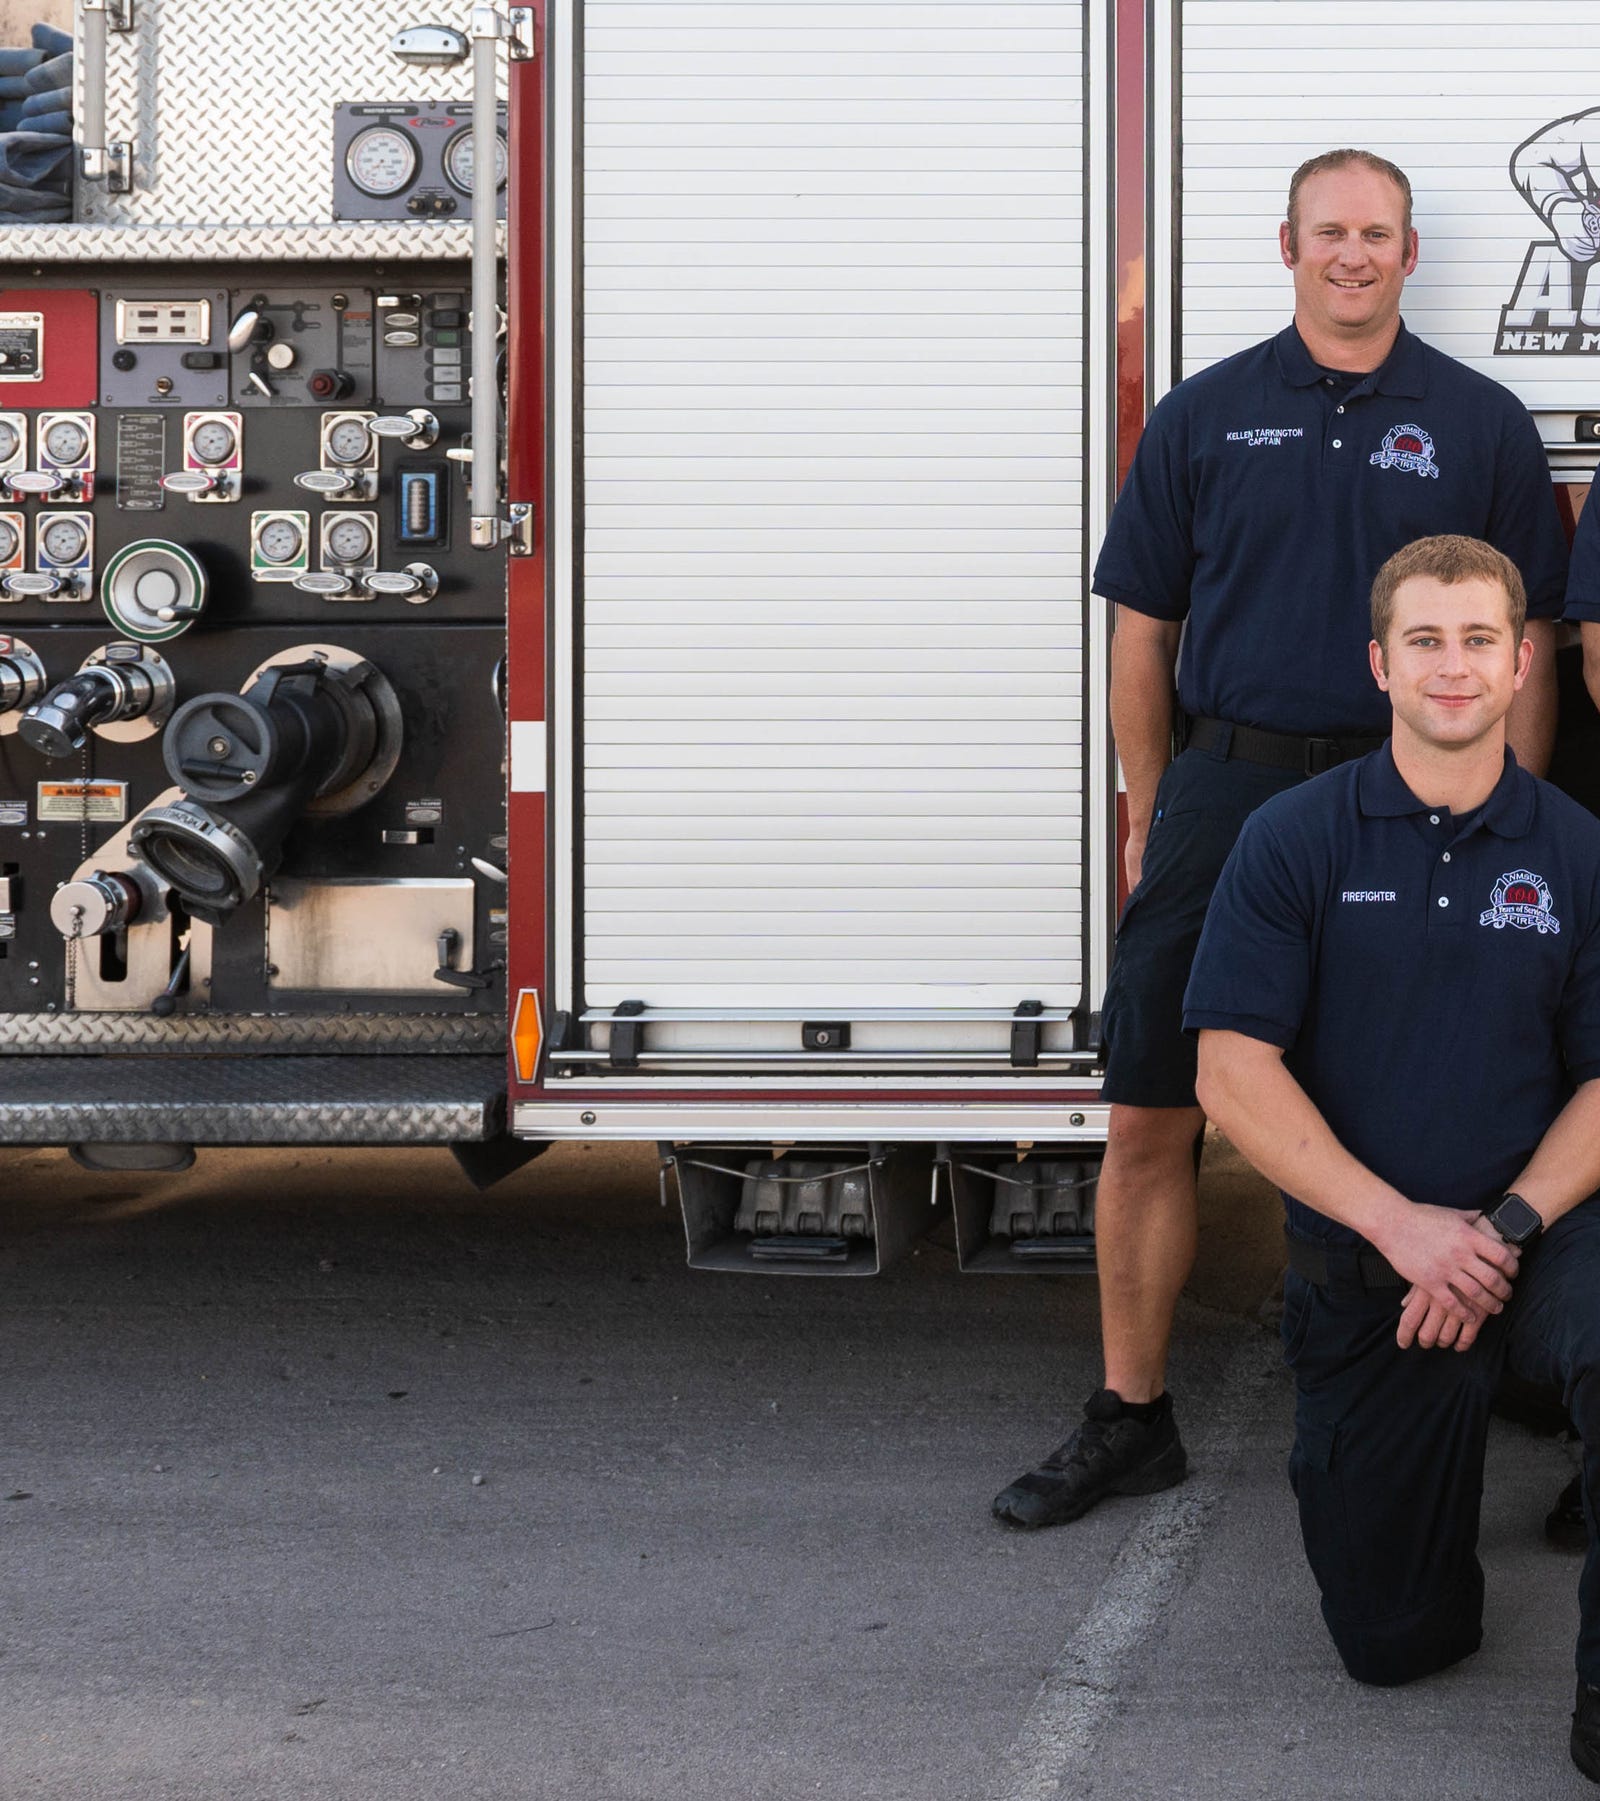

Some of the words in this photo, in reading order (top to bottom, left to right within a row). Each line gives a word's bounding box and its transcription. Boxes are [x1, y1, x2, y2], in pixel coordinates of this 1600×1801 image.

[1500, 331, 1569, 351] NEW
[1226, 430, 1254, 441] KELLEN
[1254, 428, 1303, 438] TARKINGTON
[1400, 426, 1423, 437] NMSU
[1248, 437, 1281, 446] CAPTAIN
[1509, 872, 1536, 882] NMSU
[1342, 891, 1396, 902] FIREFIGHTER
[1523, 905, 1545, 918] Service
[1510, 914, 1536, 925] FIRE
